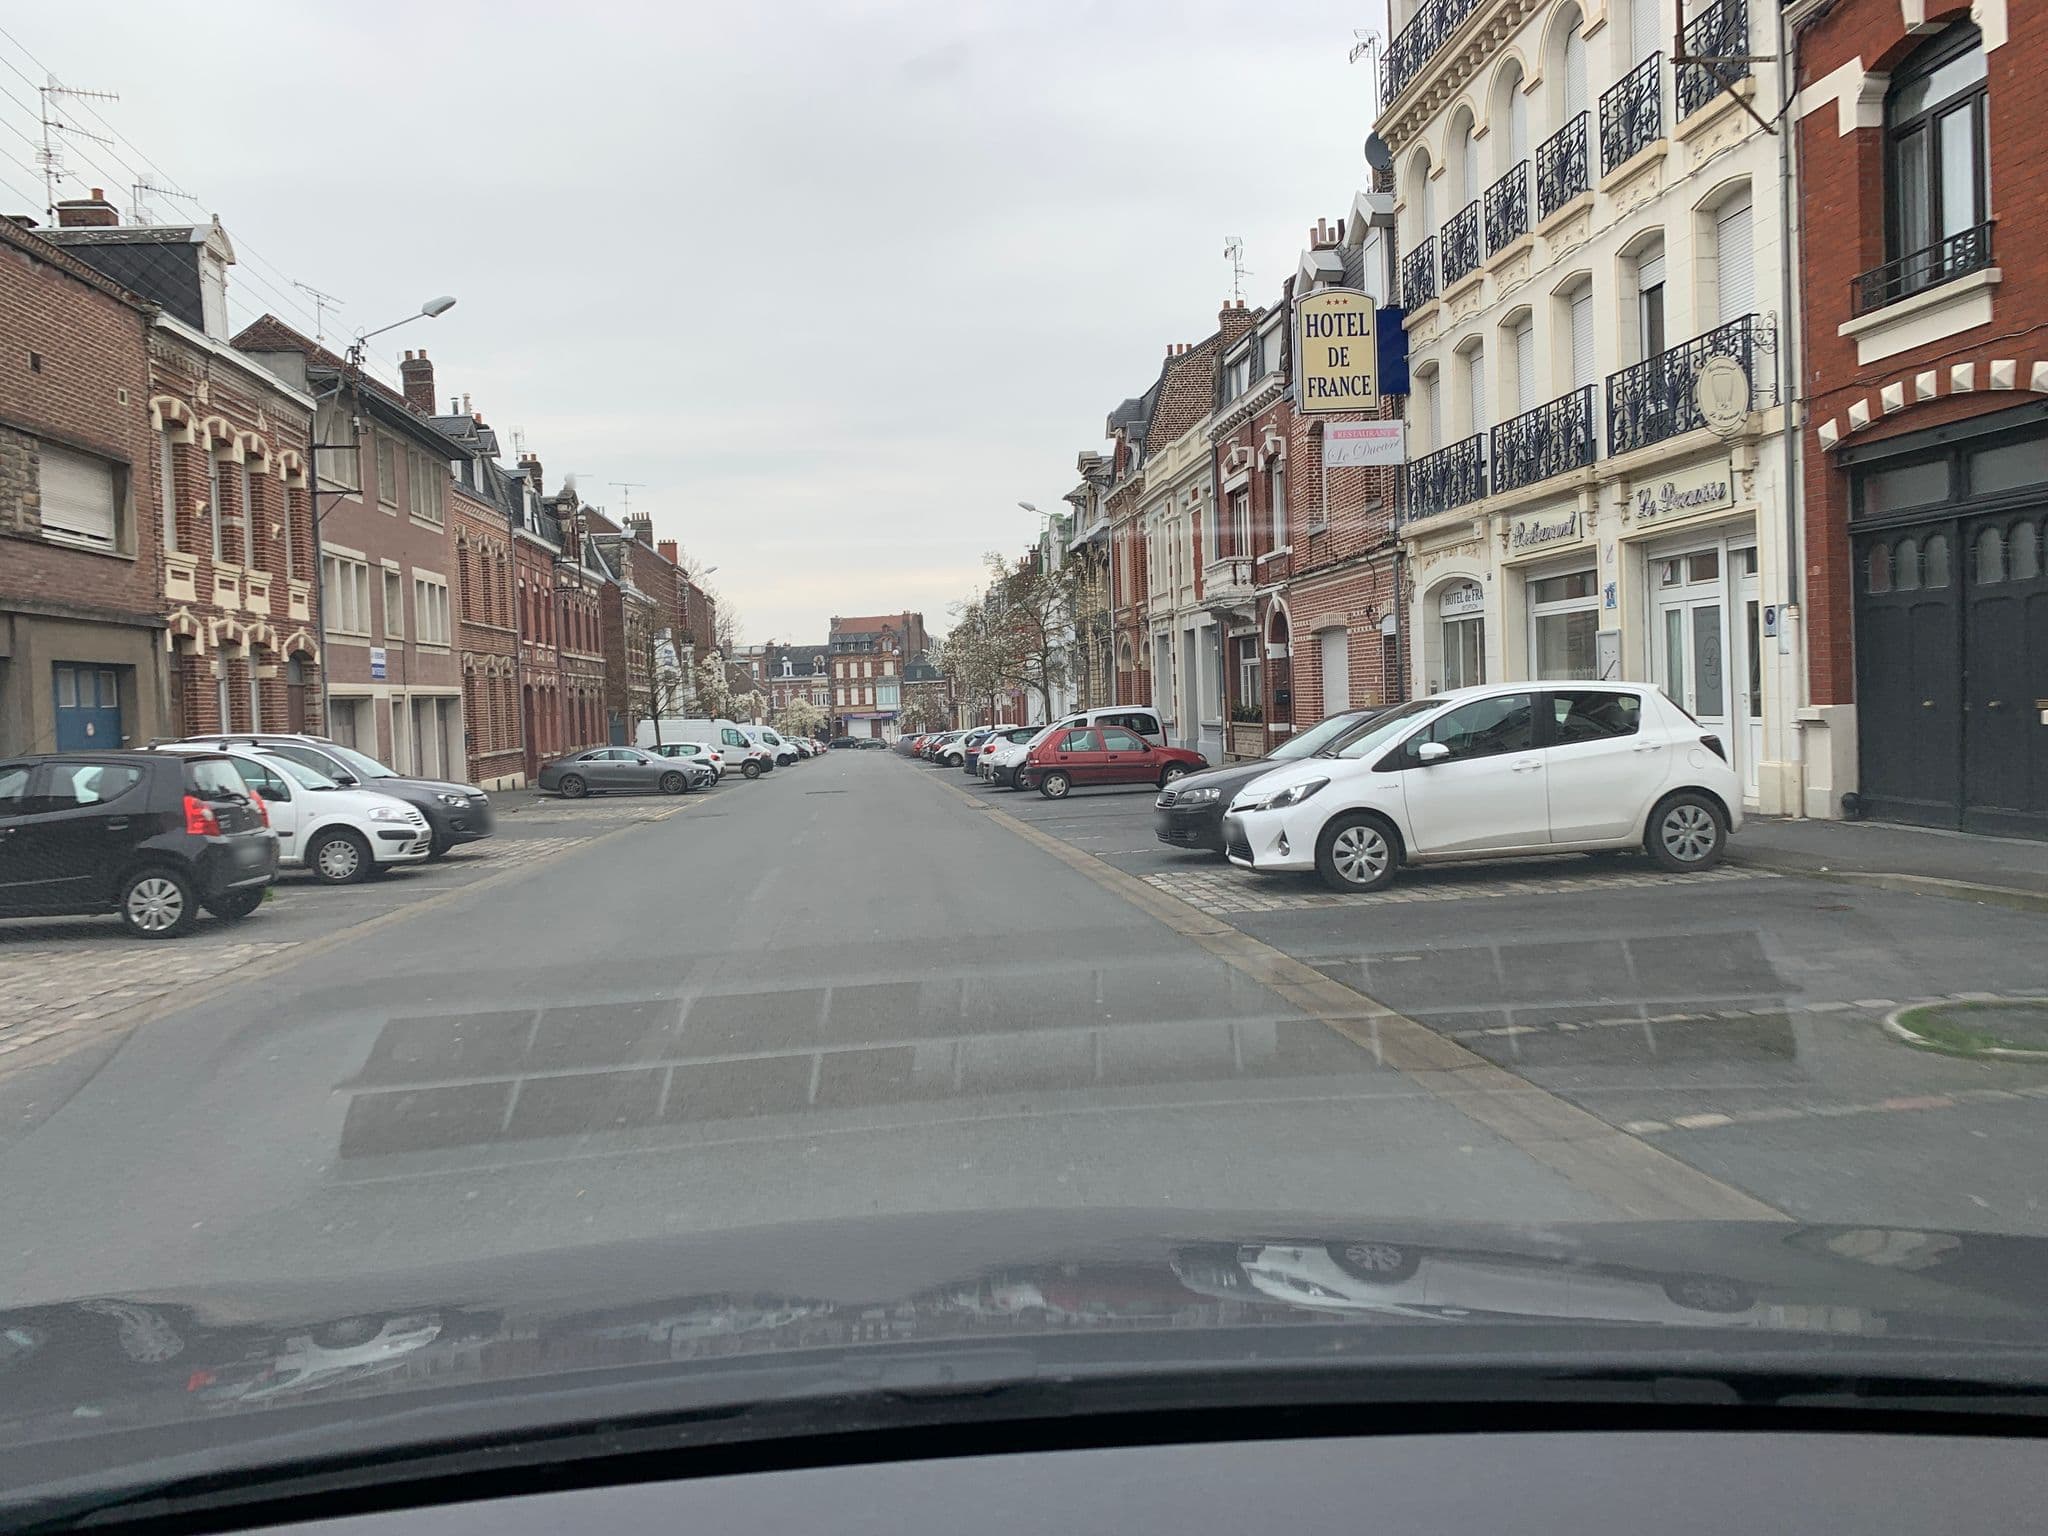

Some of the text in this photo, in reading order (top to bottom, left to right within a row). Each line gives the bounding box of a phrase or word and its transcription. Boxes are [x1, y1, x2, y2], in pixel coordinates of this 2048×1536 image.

[1306, 312, 1370, 338] HOTEL
[1328, 346, 1350, 368] DE
[1308, 375, 1372, 398] FRANCE
[1337, 429, 1392, 438] RESTAURANT
[1445, 592, 1464, 606] HOTEL
